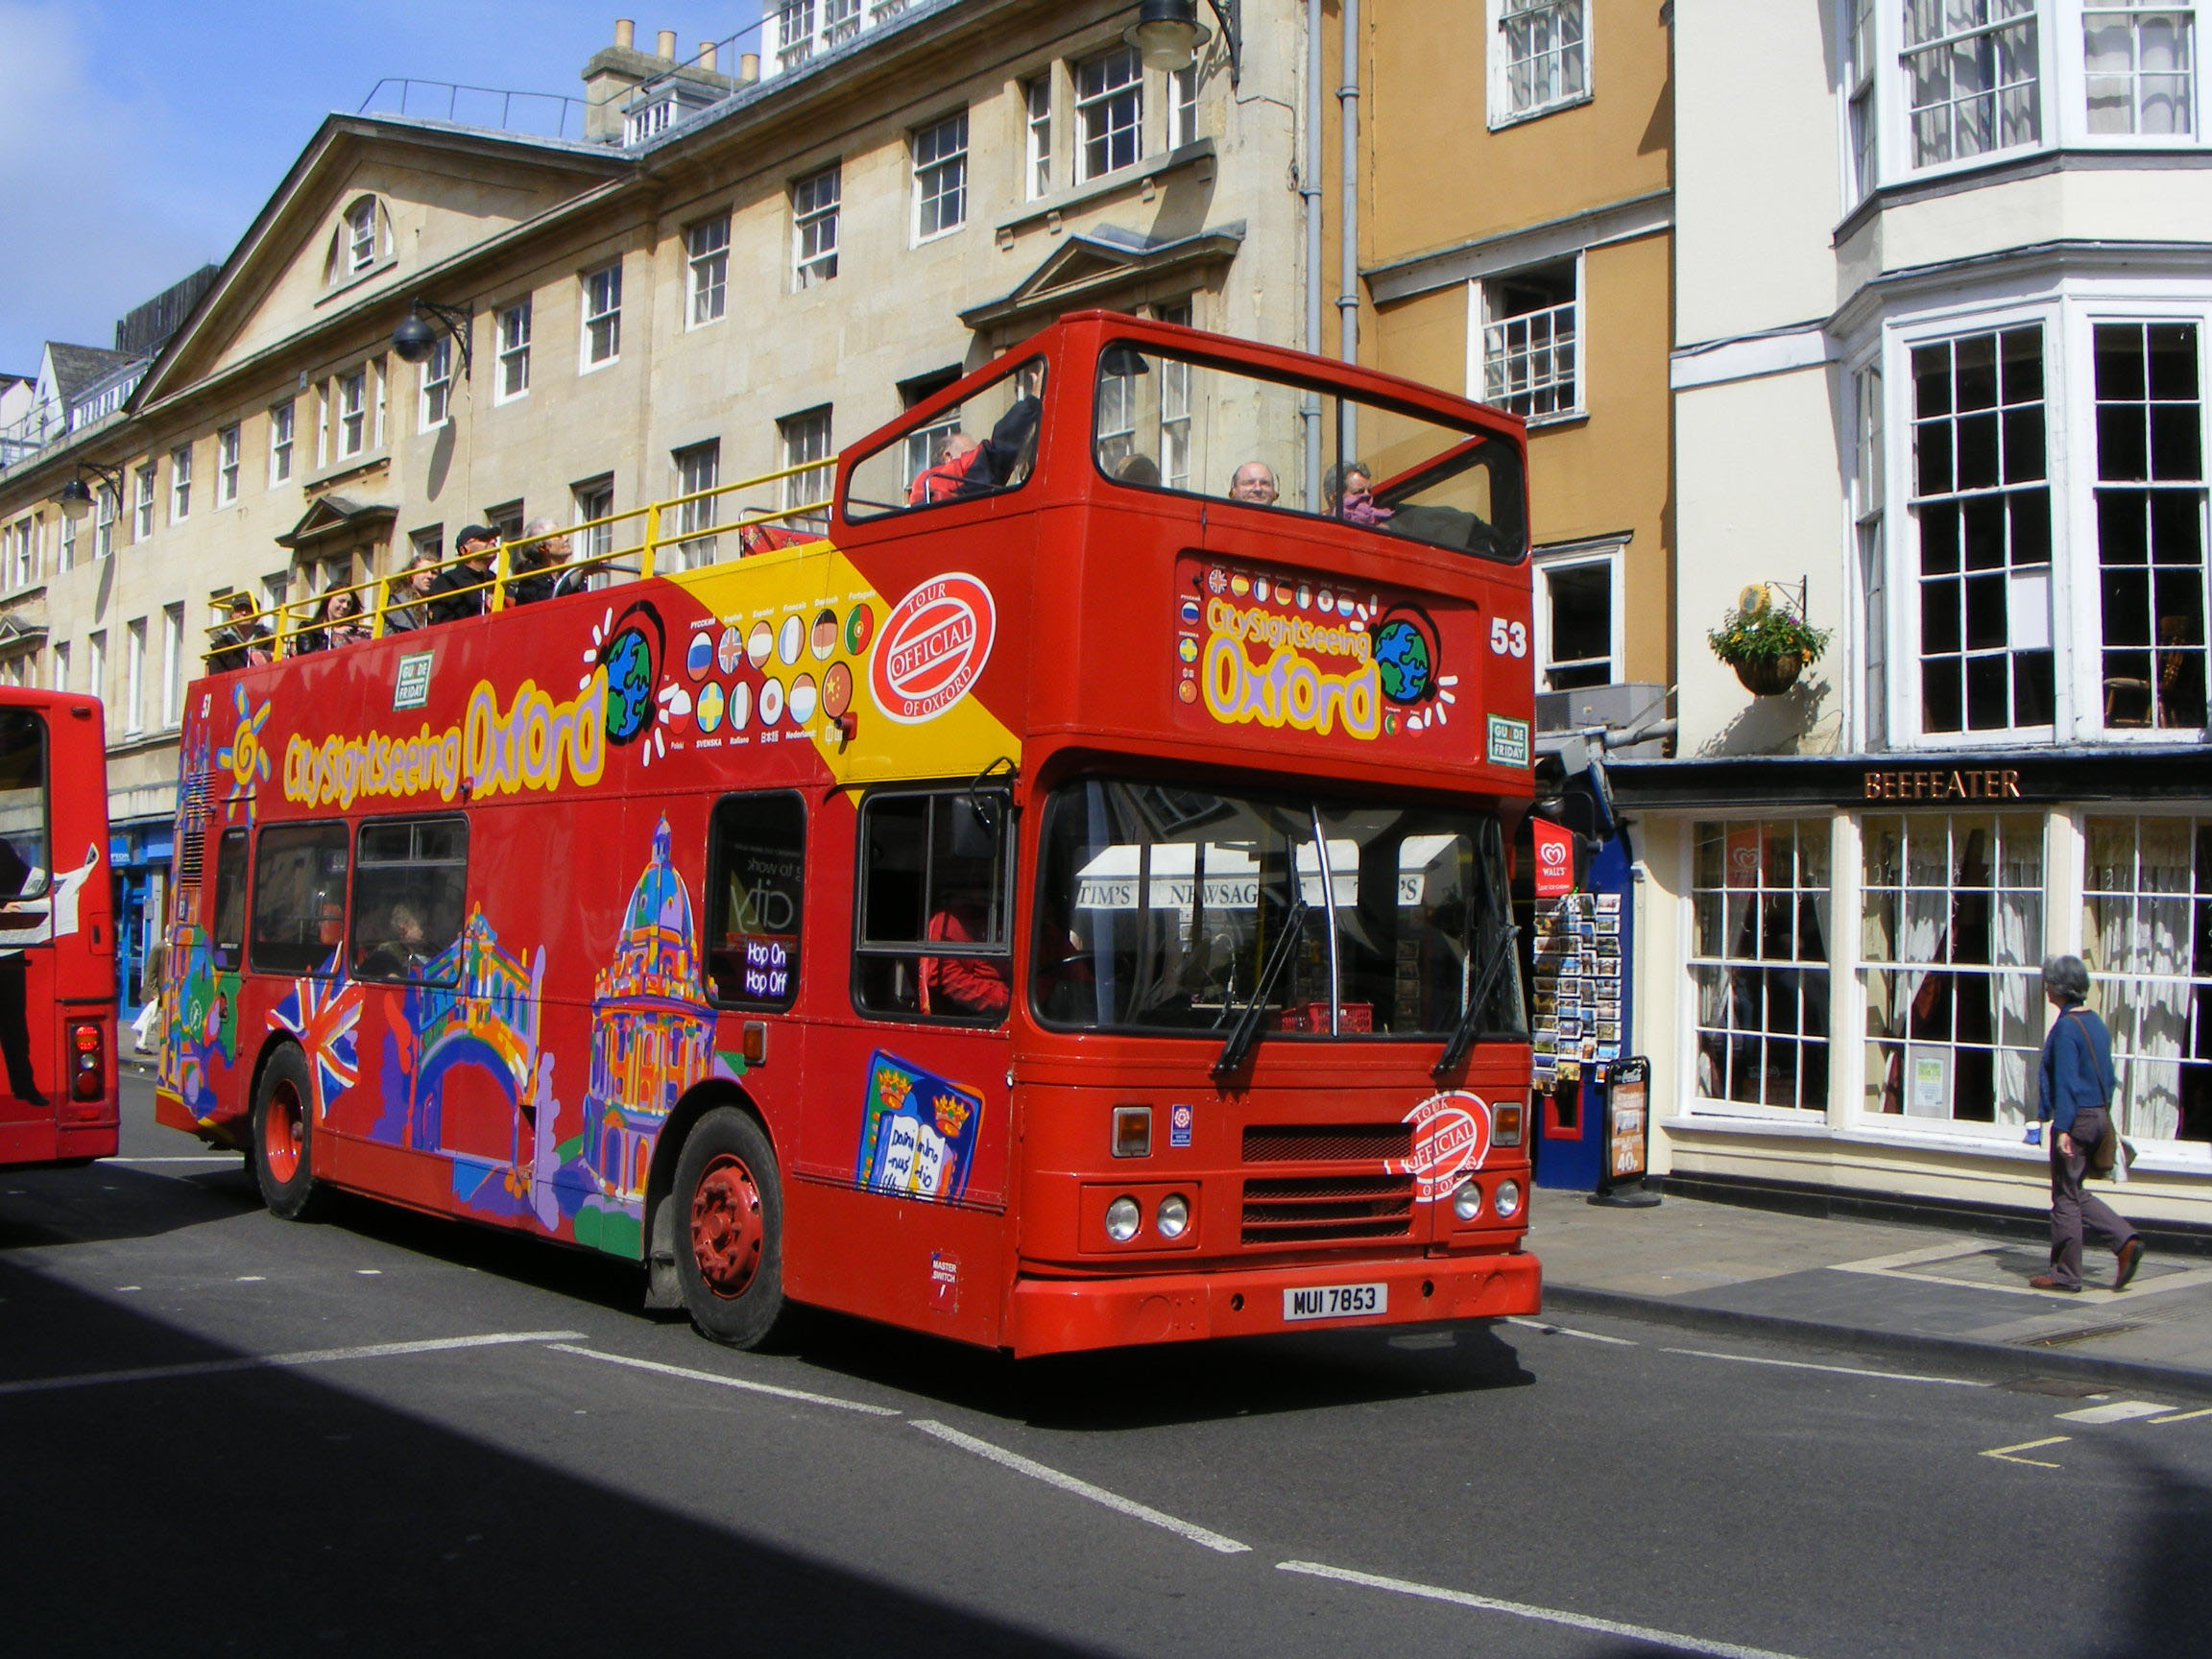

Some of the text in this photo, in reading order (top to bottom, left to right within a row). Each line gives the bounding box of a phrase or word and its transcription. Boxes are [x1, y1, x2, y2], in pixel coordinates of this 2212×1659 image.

[906, 583, 947, 614] TOUR
[892, 618, 972, 678] OFFICIAL
[1490, 616, 1527, 658] 53
[1202, 597, 1381, 740] CitySightseeing Oxford
[398, 683, 425, 701] FRIDAY
[903, 665, 973, 716] OF OXFORD
[201, 693, 212, 719] 53
[284, 664, 609, 810] CitySightseeing Oxford
[696, 737, 722, 748] SVENSKA
[1494, 743, 1525, 758] FRIDAY
[1864, 770, 2020, 798] BEEFEATER
[1542, 867, 1566, 877] WALL'S
[1077, 885, 1131, 904] TIM'S
[748, 943, 768, 966] Hop
[771, 943, 786, 965] On
[746, 971, 788, 994] Hop Off
[931, 1270, 956, 1284] SWITCH
[932, 1260, 957, 1273] MASTER
[1294, 1287, 1376, 1314] MUI 7853
